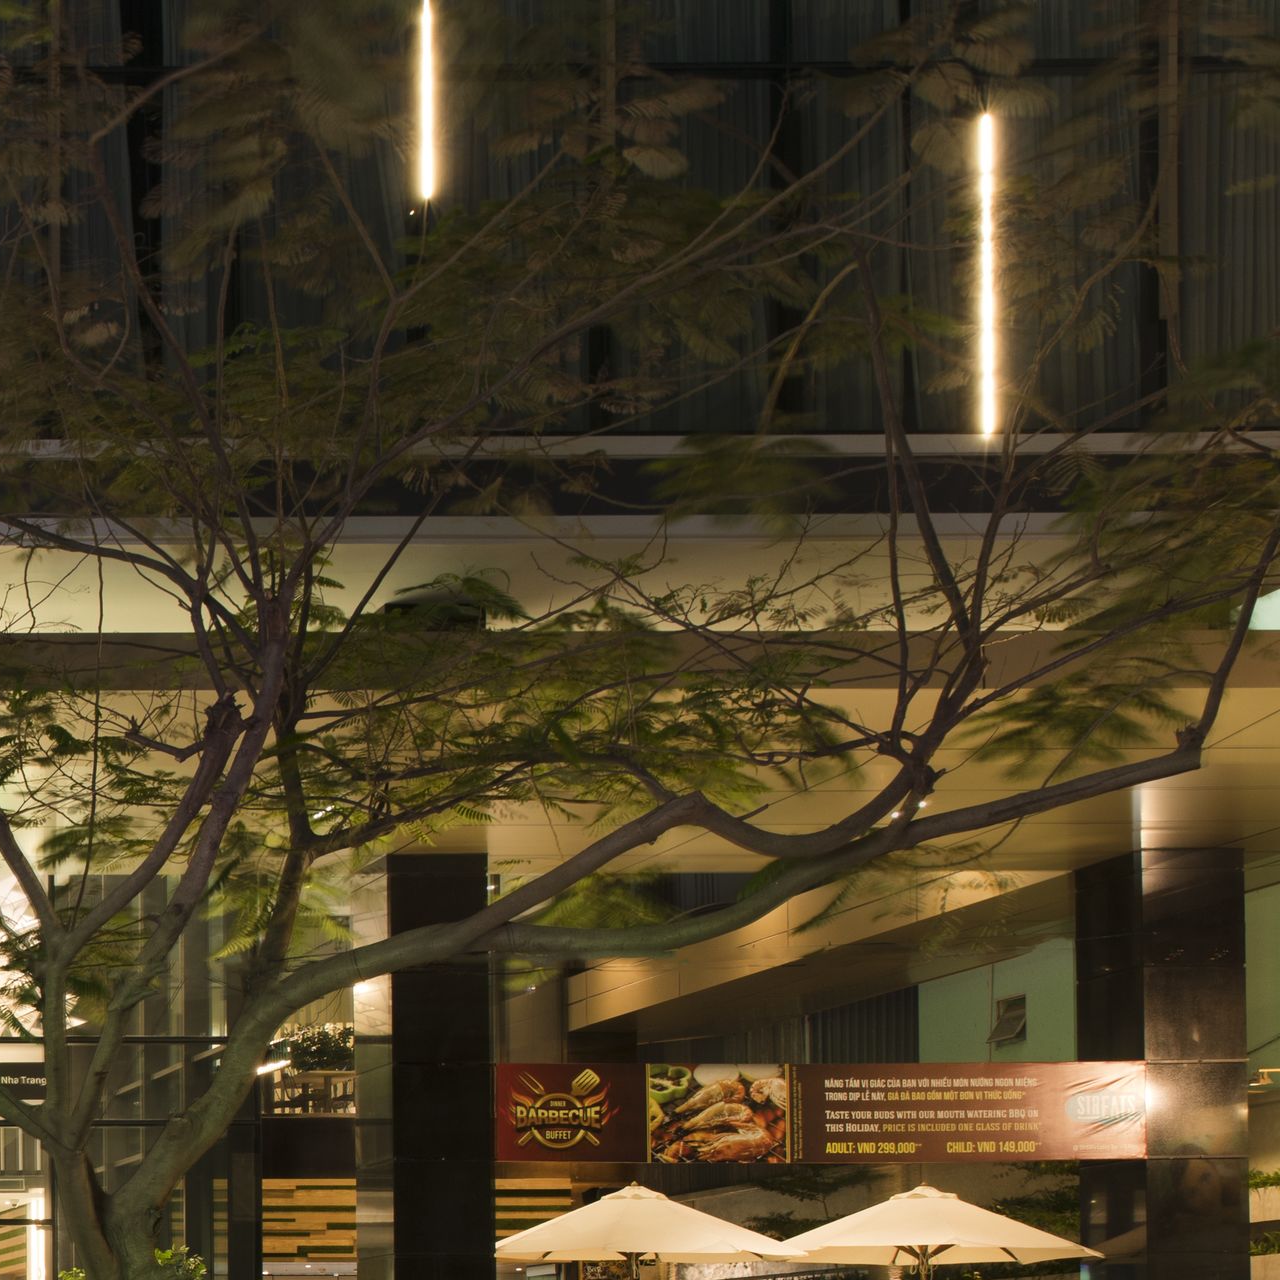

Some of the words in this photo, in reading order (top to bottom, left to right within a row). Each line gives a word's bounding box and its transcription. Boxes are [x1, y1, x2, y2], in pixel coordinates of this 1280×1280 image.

[0, 1076, 19, 1085] Nha
[20, 1076, 47, 1086] Trang
[825, 1092, 847, 1101] TRONG
[911, 1090, 925, 1101] BAO
[516, 1105, 601, 1129] BARBECUE
[825, 1110, 850, 1120] TASTE
[851, 1110, 872, 1120] YOUR
[874, 1110, 895, 1120] BUDS
[896, 1110, 917, 1120] WITH
[918, 1110, 935, 1120] OUR
[937, 1110, 965, 1120] MOUTH
[966, 1110, 1007, 1120] WATERING
[1008, 1109, 1026, 1119] BBQ
[1027, 1110, 1039, 1118] ON
[825, 1124, 844, 1132] THIS
[845, 1123, 881, 1133] HOLIDAY,
[882, 1123, 906, 1132] PRICE
[908, 1123, 916, 1132] IS
[917, 1123, 956, 1132] INCLUDED
[958, 1123, 973, 1132] ONE
[976, 1122, 1000, 1131] GLASS
[1002, 1122, 1012, 1131] OF
[545, 1130, 571, 1140] BUFFET
[825, 1142, 856, 1154] ADULT:
[857, 1142, 876, 1154] VND
[946, 1141, 976, 1153] CHILD:
[977, 1141, 996, 1153] VND
